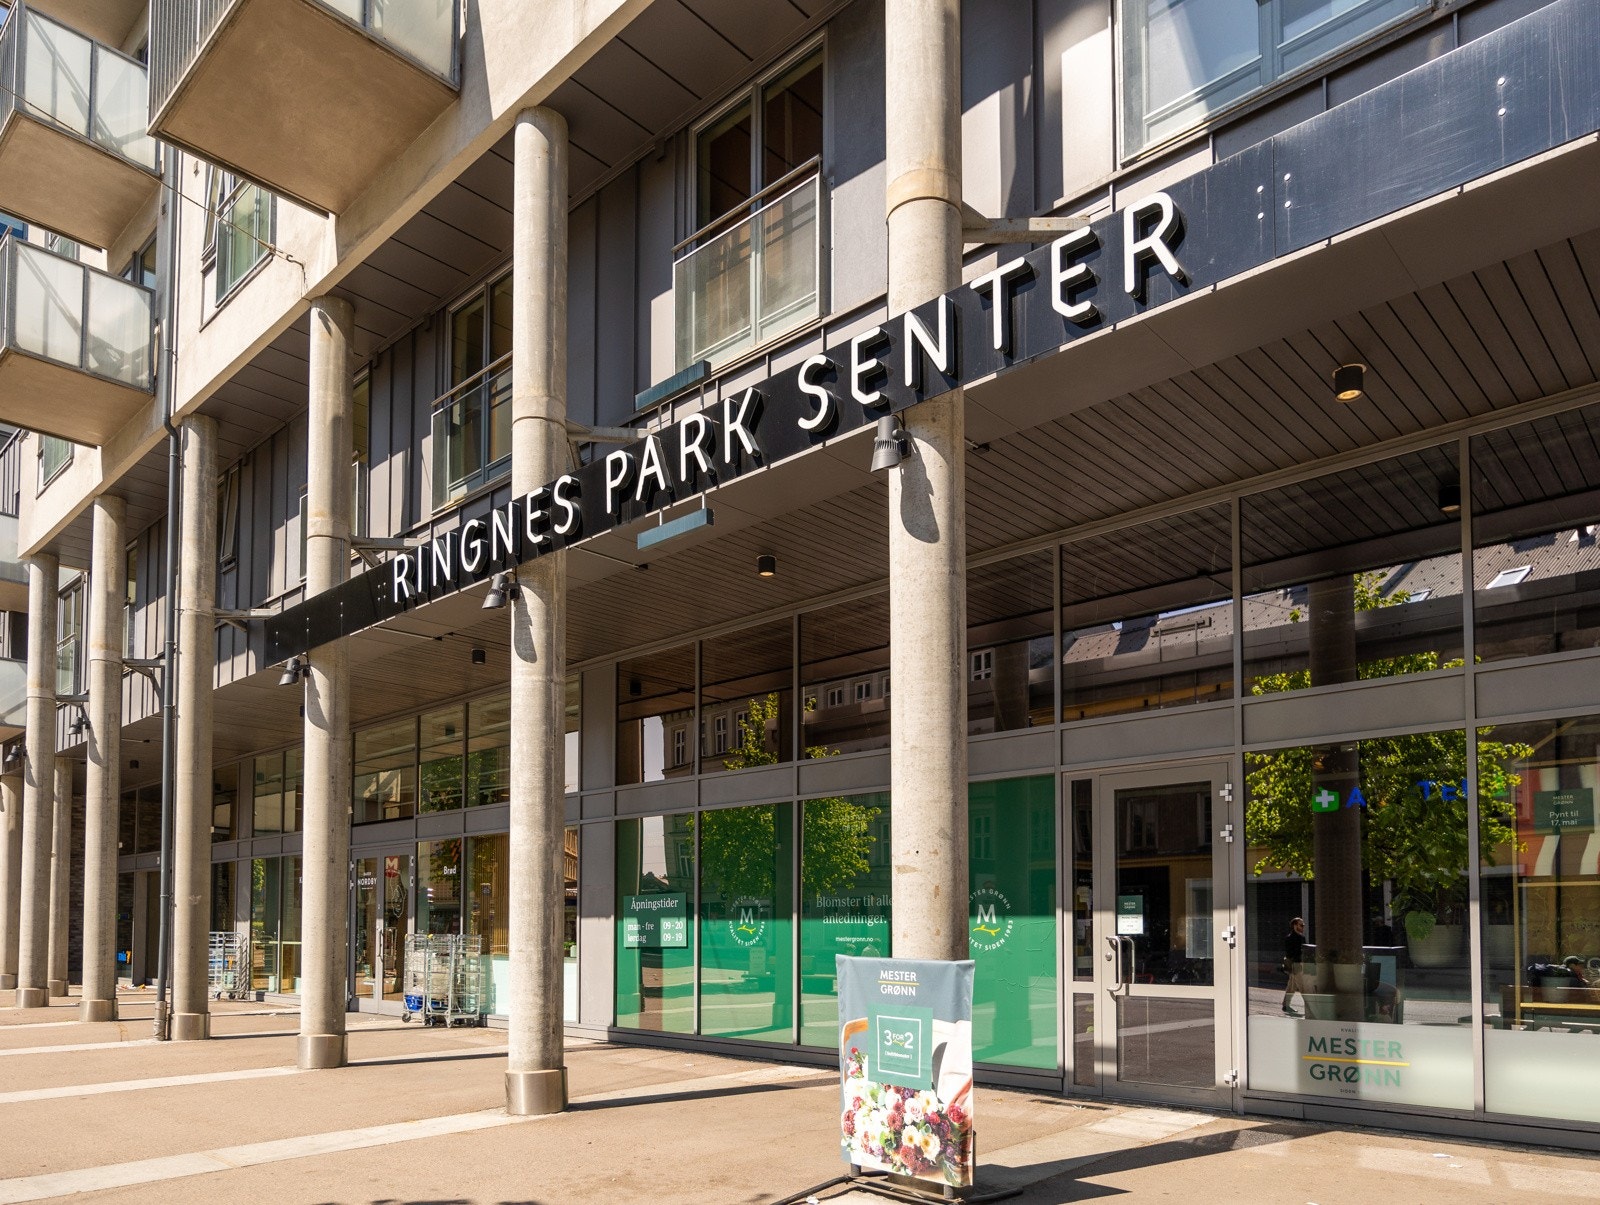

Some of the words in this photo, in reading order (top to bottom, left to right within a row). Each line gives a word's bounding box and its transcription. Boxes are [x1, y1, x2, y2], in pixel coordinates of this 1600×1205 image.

[394, 474, 581, 603] RINGNES
[606, 388, 762, 515] PARK
[798, 191, 1183, 432] SENTER
[1549, 811, 1569, 819] Pynt
[443, 865, 457, 875] Brød
[357, 877, 377, 886] NORDBY
[630, 897, 679, 912] Åpningstider
[816, 895, 861, 908] Blomster
[863, 894, 874, 907] til
[739, 907, 754, 925] M
[822, 912, 887, 926] anledninger.
[976, 903, 997, 925] M
[645, 922, 655, 930] fre
[663, 921, 671, 930] 09
[984, 937, 1006, 951] SIDEN
[880, 970, 917, 982] MESTER
[880, 984, 916, 997] GRØNN
[883, 1029, 893, 1046] 3
[892, 1033, 904, 1041] FOR
[903, 1031, 914, 1049] 2
[1308, 1036, 1403, 1059] MESTER
[1309, 1063, 1401, 1088] GRØNN
